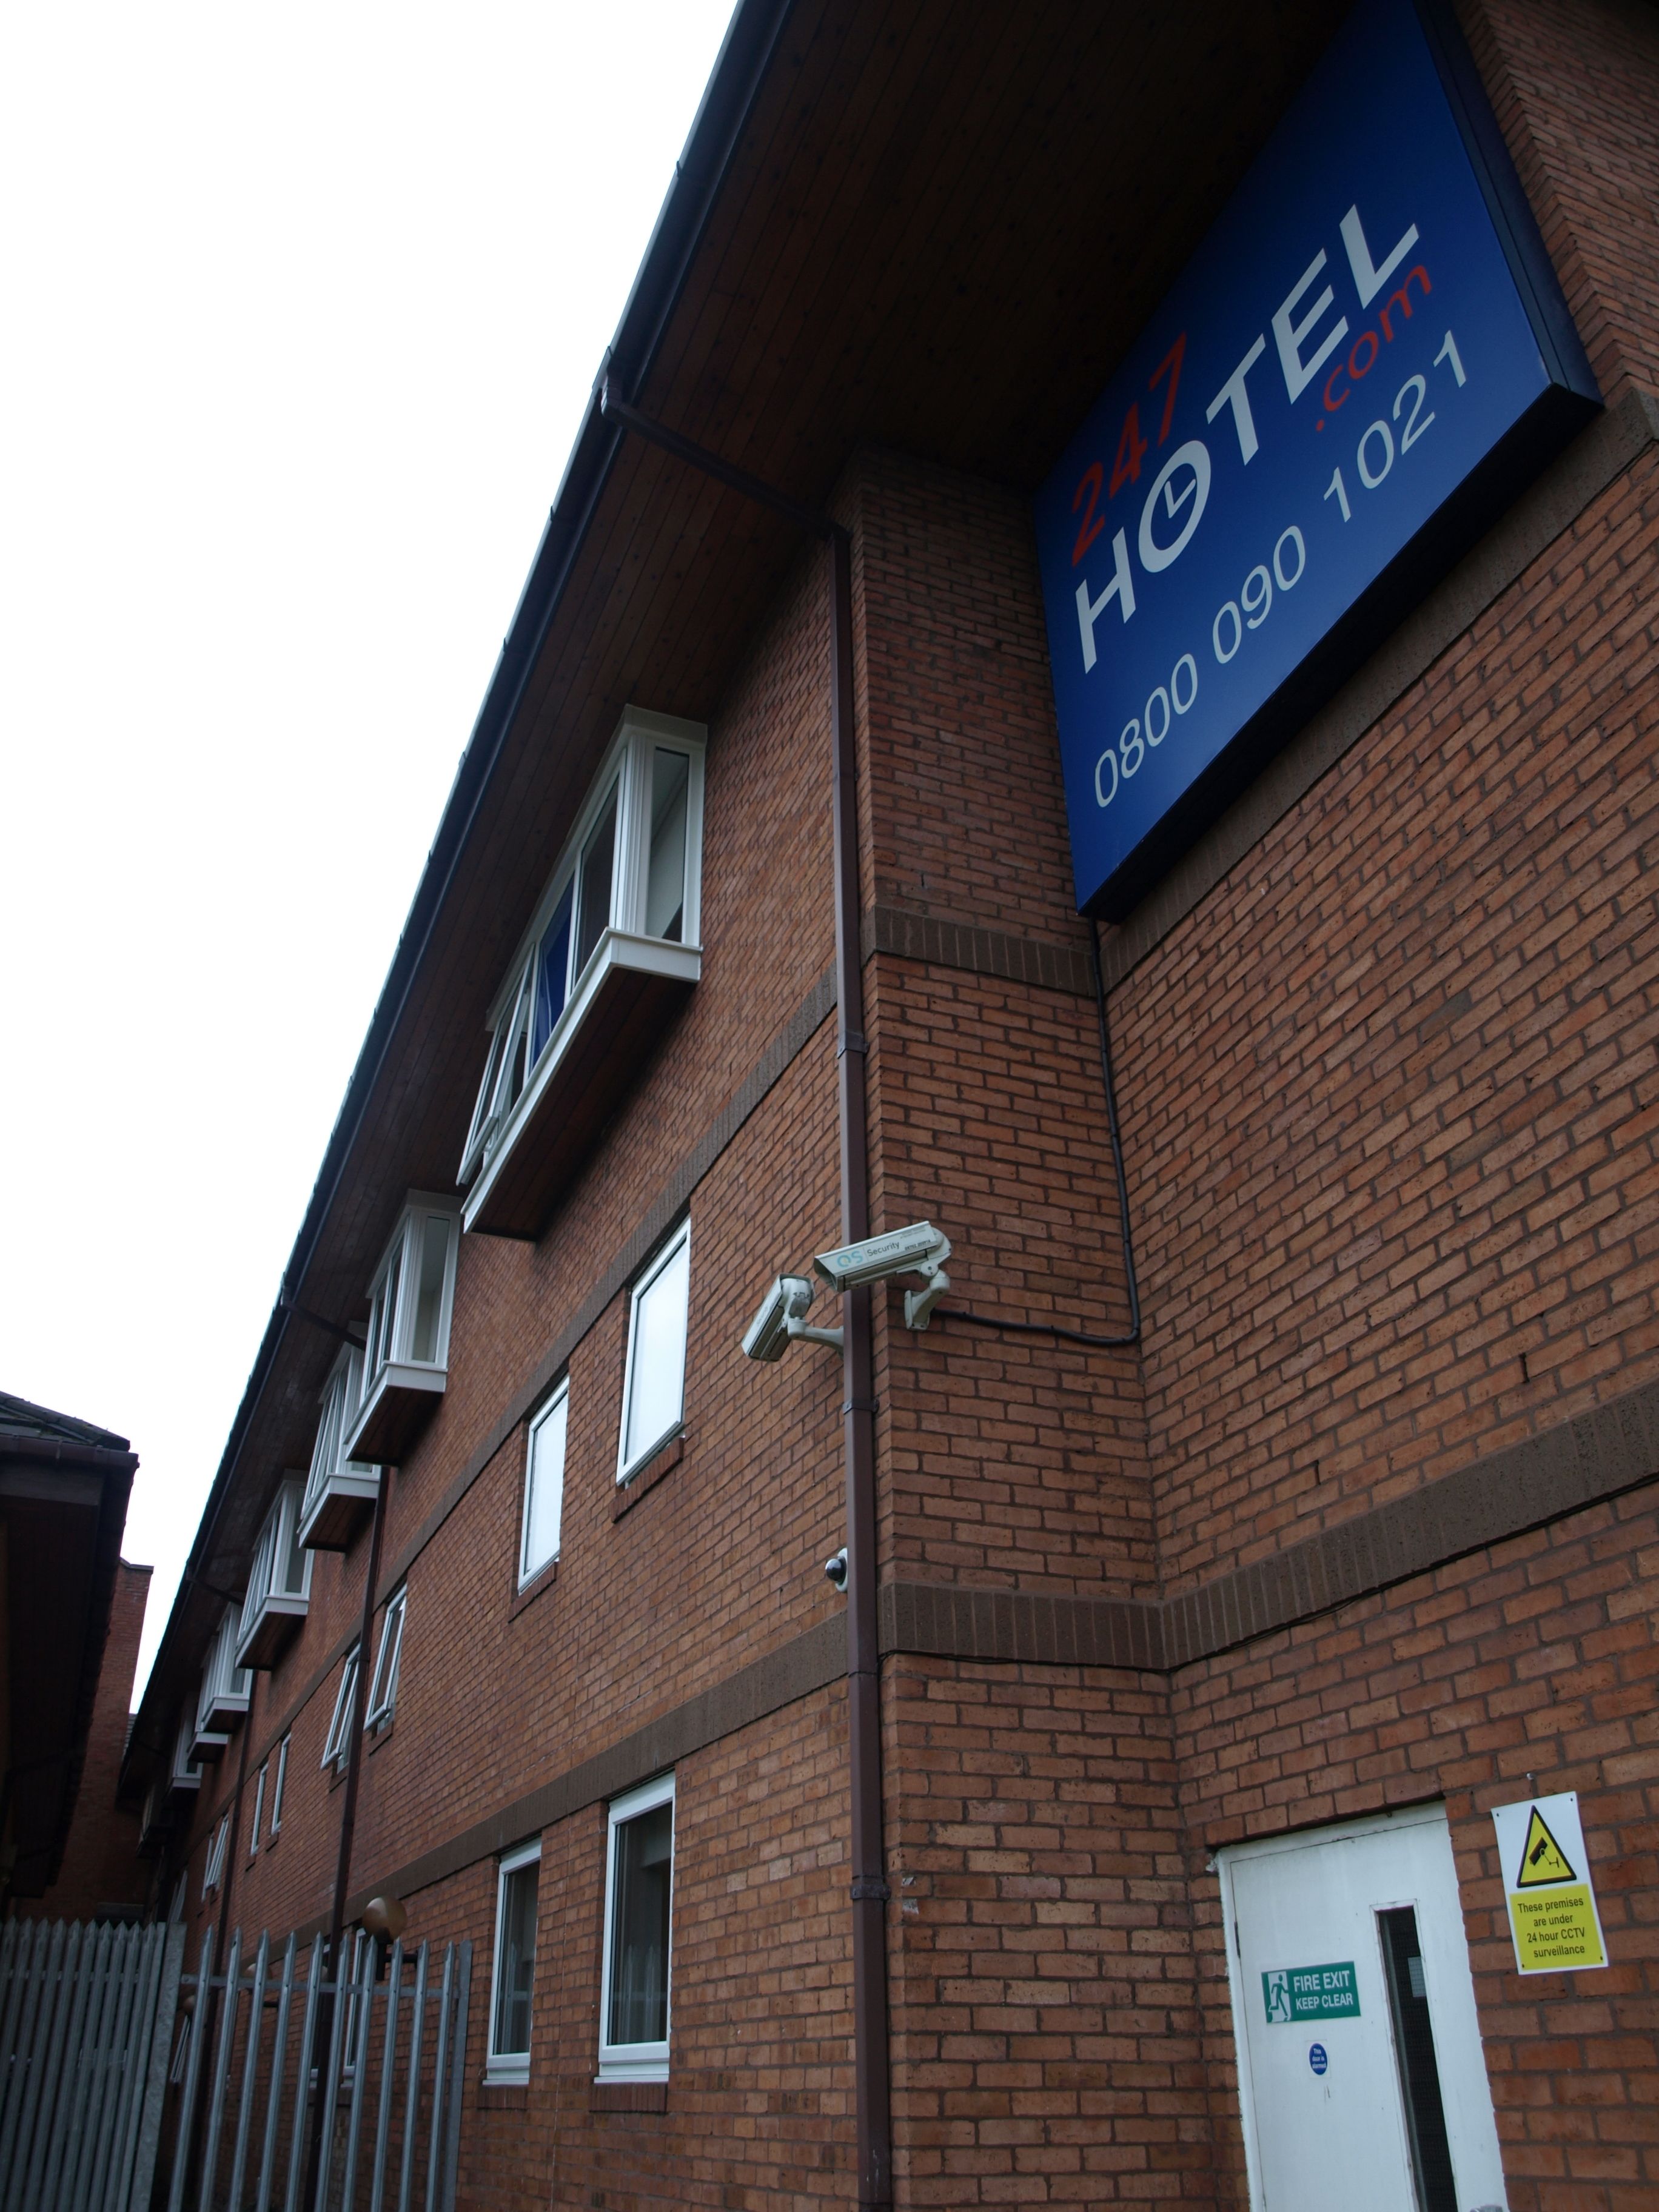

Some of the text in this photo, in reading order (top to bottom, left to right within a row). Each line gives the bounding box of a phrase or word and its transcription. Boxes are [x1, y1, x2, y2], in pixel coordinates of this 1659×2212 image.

[1076, 204, 1419, 674] HOTEL
[1071, 332, 1186, 566] 247
[1095, 329, 1468, 807] 0800 090 1021
[867, 1241, 900, 1257] Security
[1518, 1897, 1584, 1913] These premises
[1533, 1914, 1573, 1927] are under
[1527, 1927, 1585, 1943] 24 hour CCTV
[1533, 1945, 1585, 1957] surveillance
[1293, 1970, 1350, 1992] FIRE EXIT
[1296, 1992, 1353, 2010] KEEP CLEAR
